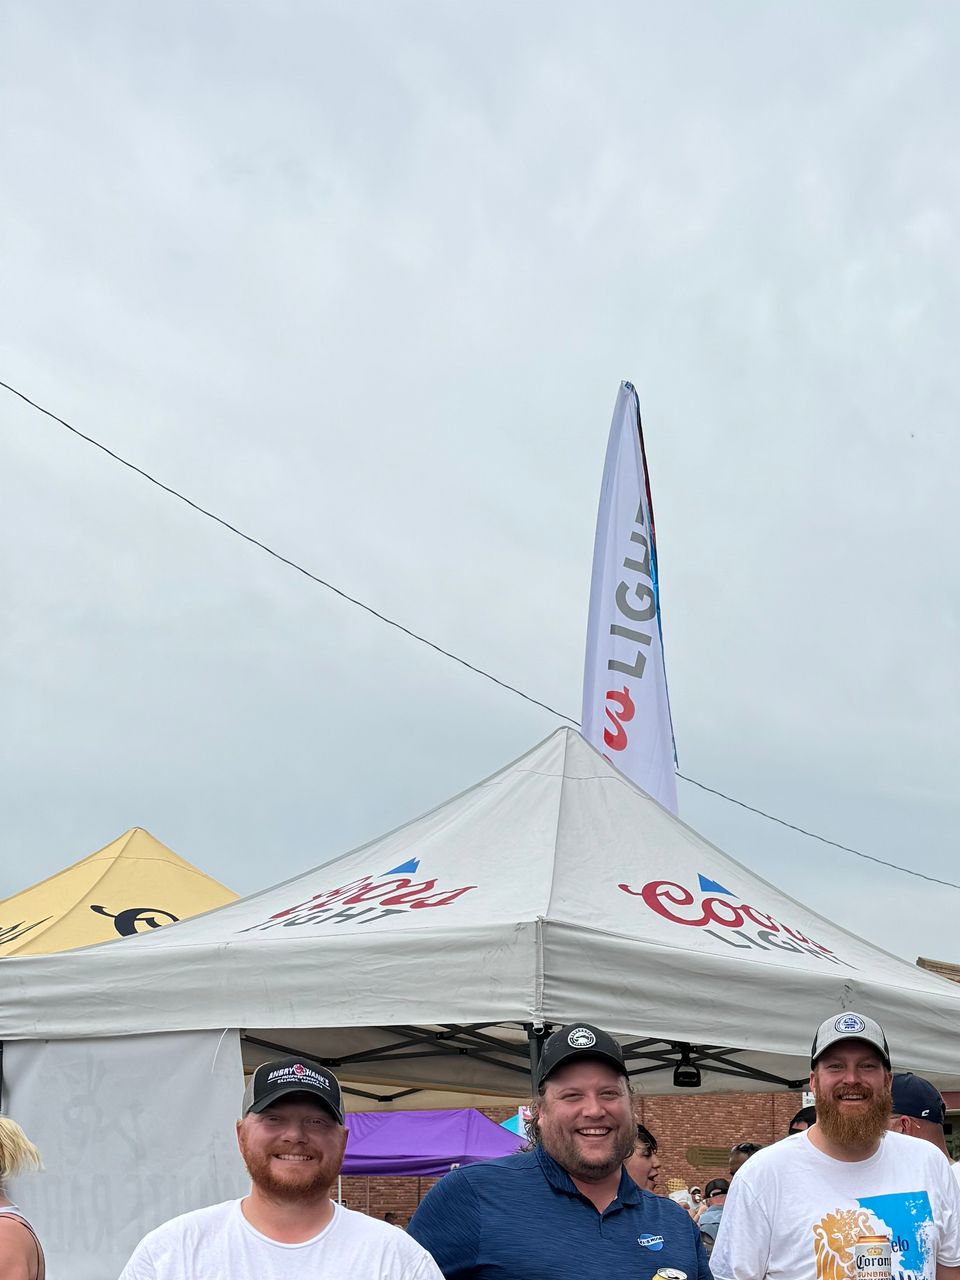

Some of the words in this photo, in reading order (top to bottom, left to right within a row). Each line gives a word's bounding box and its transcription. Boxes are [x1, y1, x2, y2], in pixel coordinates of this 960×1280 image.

[617, 880, 835, 954] Coors
[702, 927, 860, 971] LIGHT
[267, 1067, 294, 1080] ANGRY
[891, 1236, 909, 1252] elo
[856, 1255, 891, 1271] Coron
